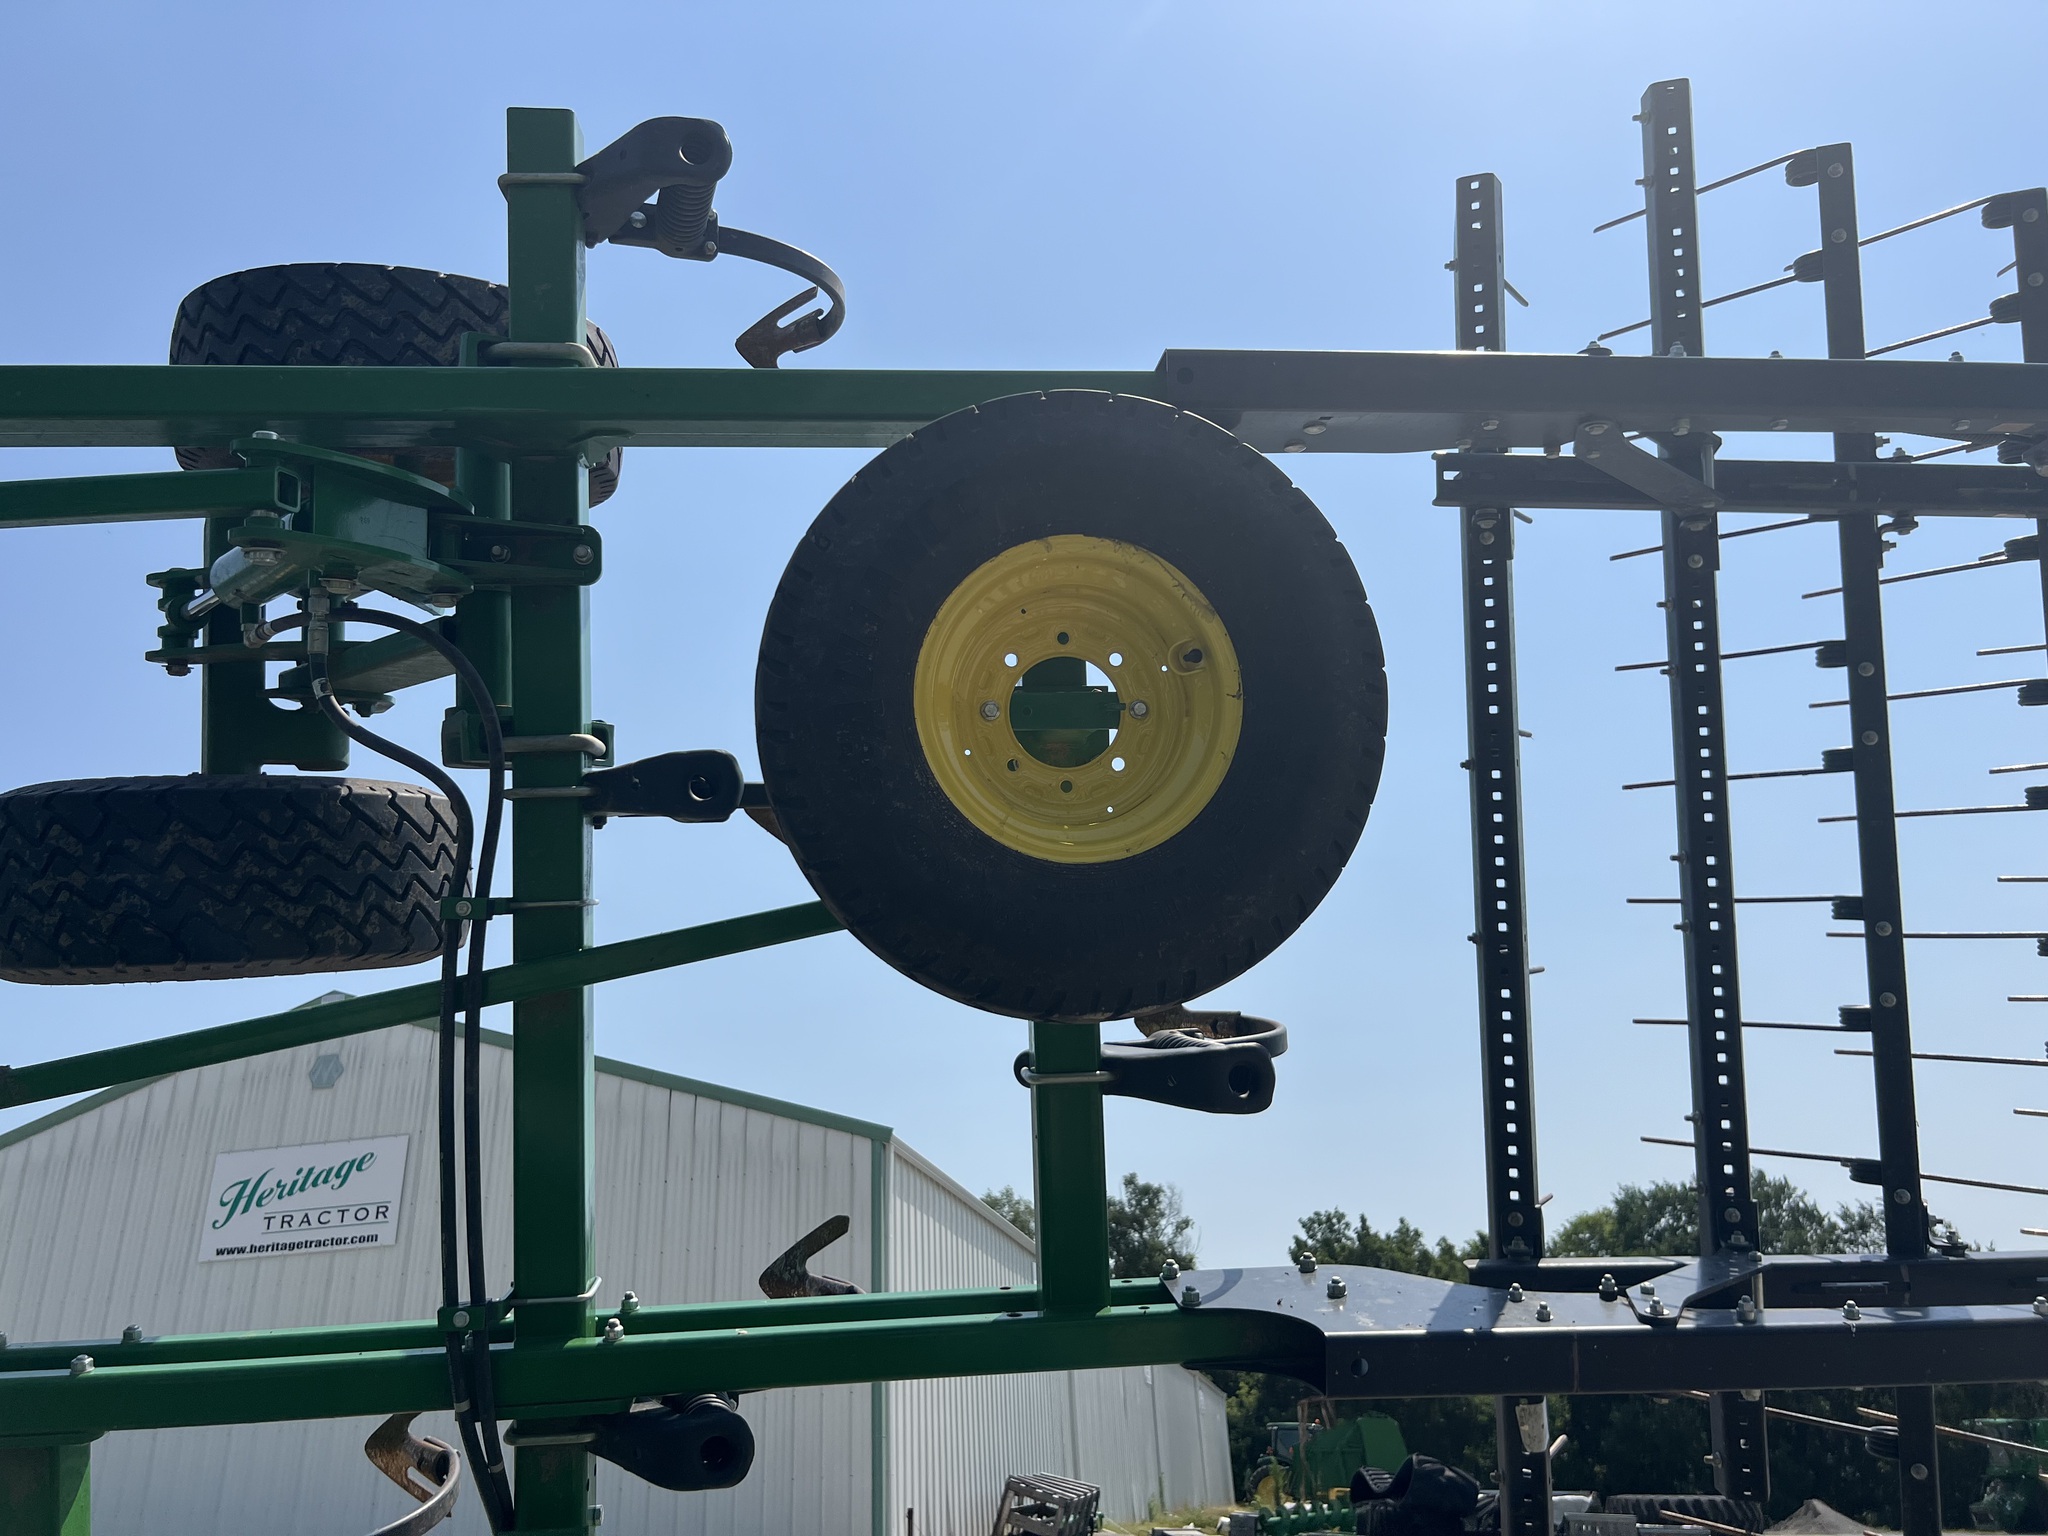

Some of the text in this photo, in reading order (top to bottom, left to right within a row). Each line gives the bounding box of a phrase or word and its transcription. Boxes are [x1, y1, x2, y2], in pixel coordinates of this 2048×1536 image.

[212, 1152, 377, 1229] Heritage
[264, 1205, 390, 1230] TRACTOR
[216, 1233, 379, 1256] www.heritagetractor.com
